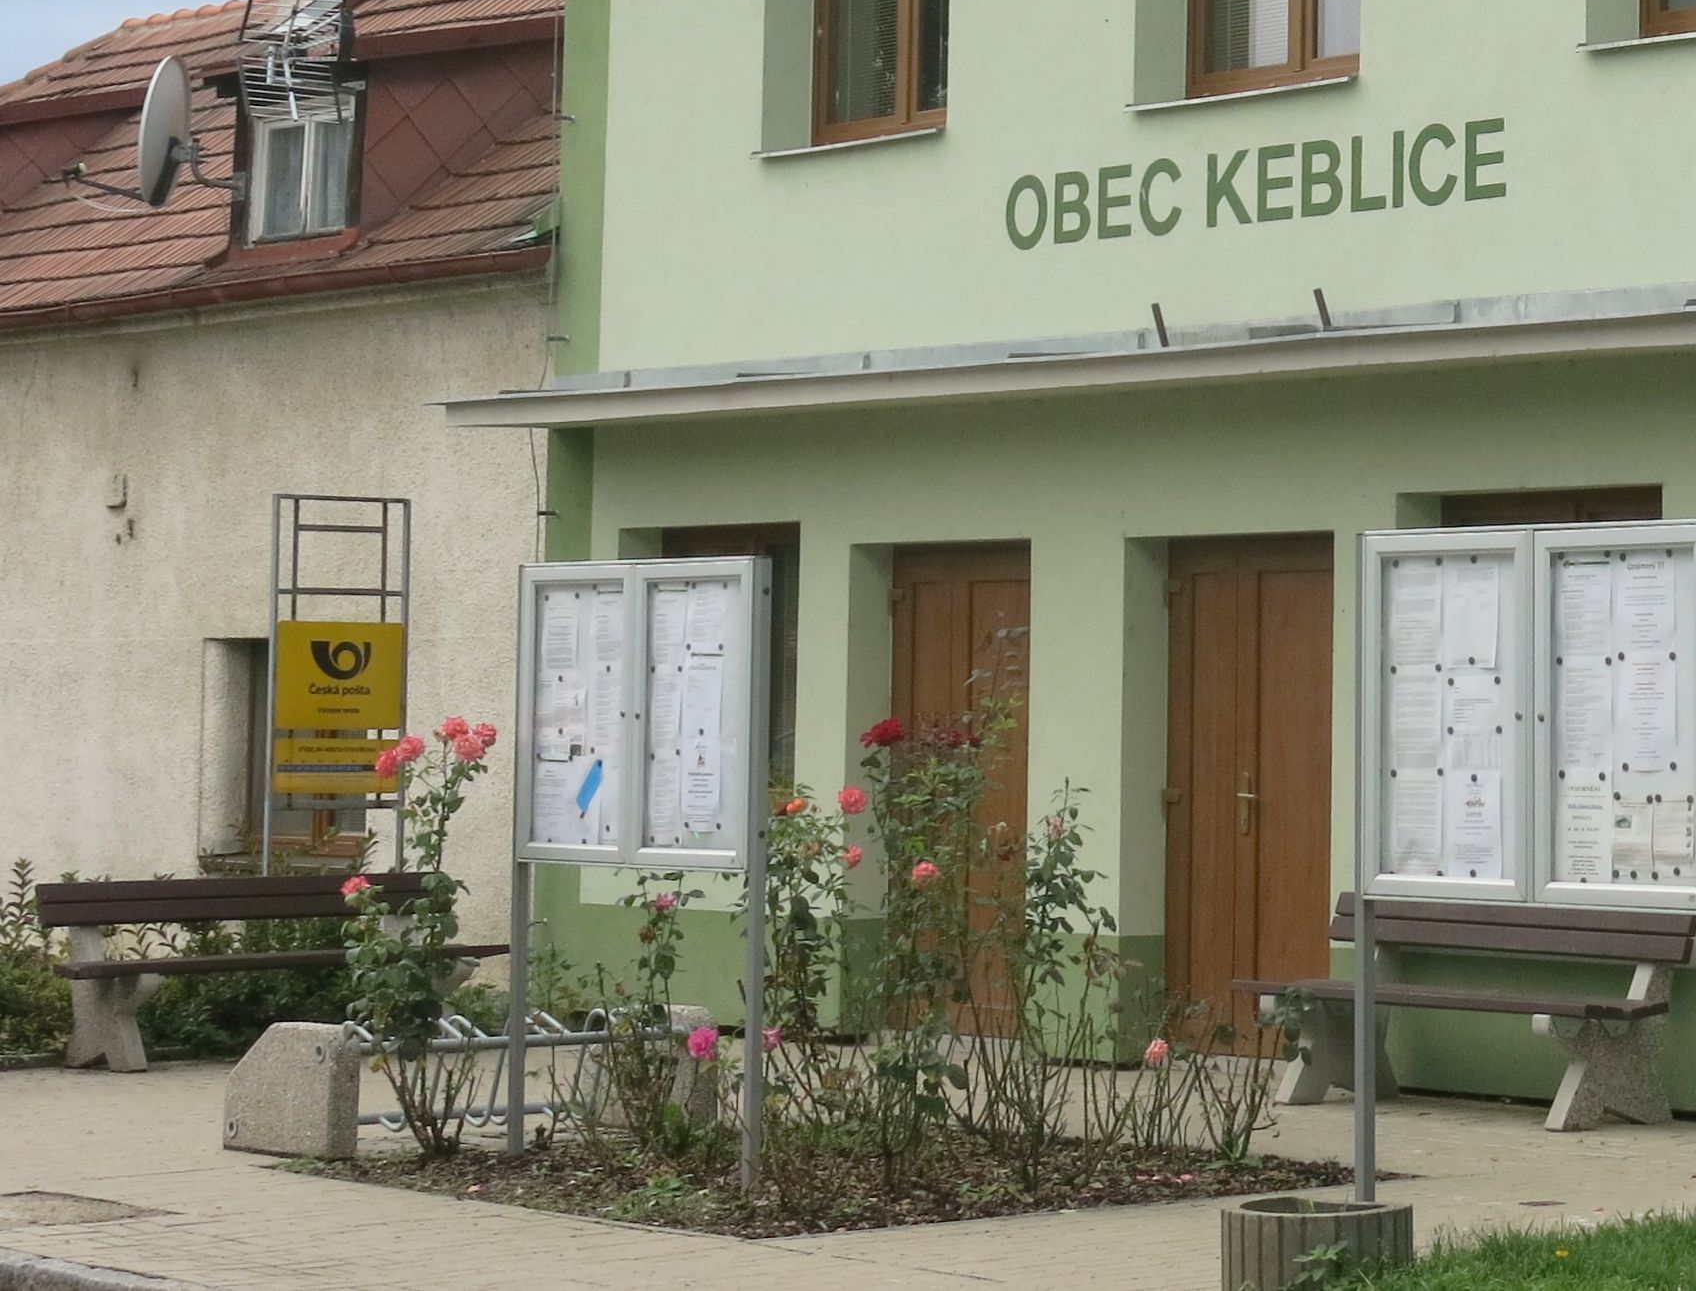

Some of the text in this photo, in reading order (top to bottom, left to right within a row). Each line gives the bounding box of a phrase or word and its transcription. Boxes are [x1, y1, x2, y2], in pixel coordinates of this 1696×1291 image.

[1004, 117, 1507, 251] OBEC KEBLICE
[309, 682, 371, 697] Česká pošta
